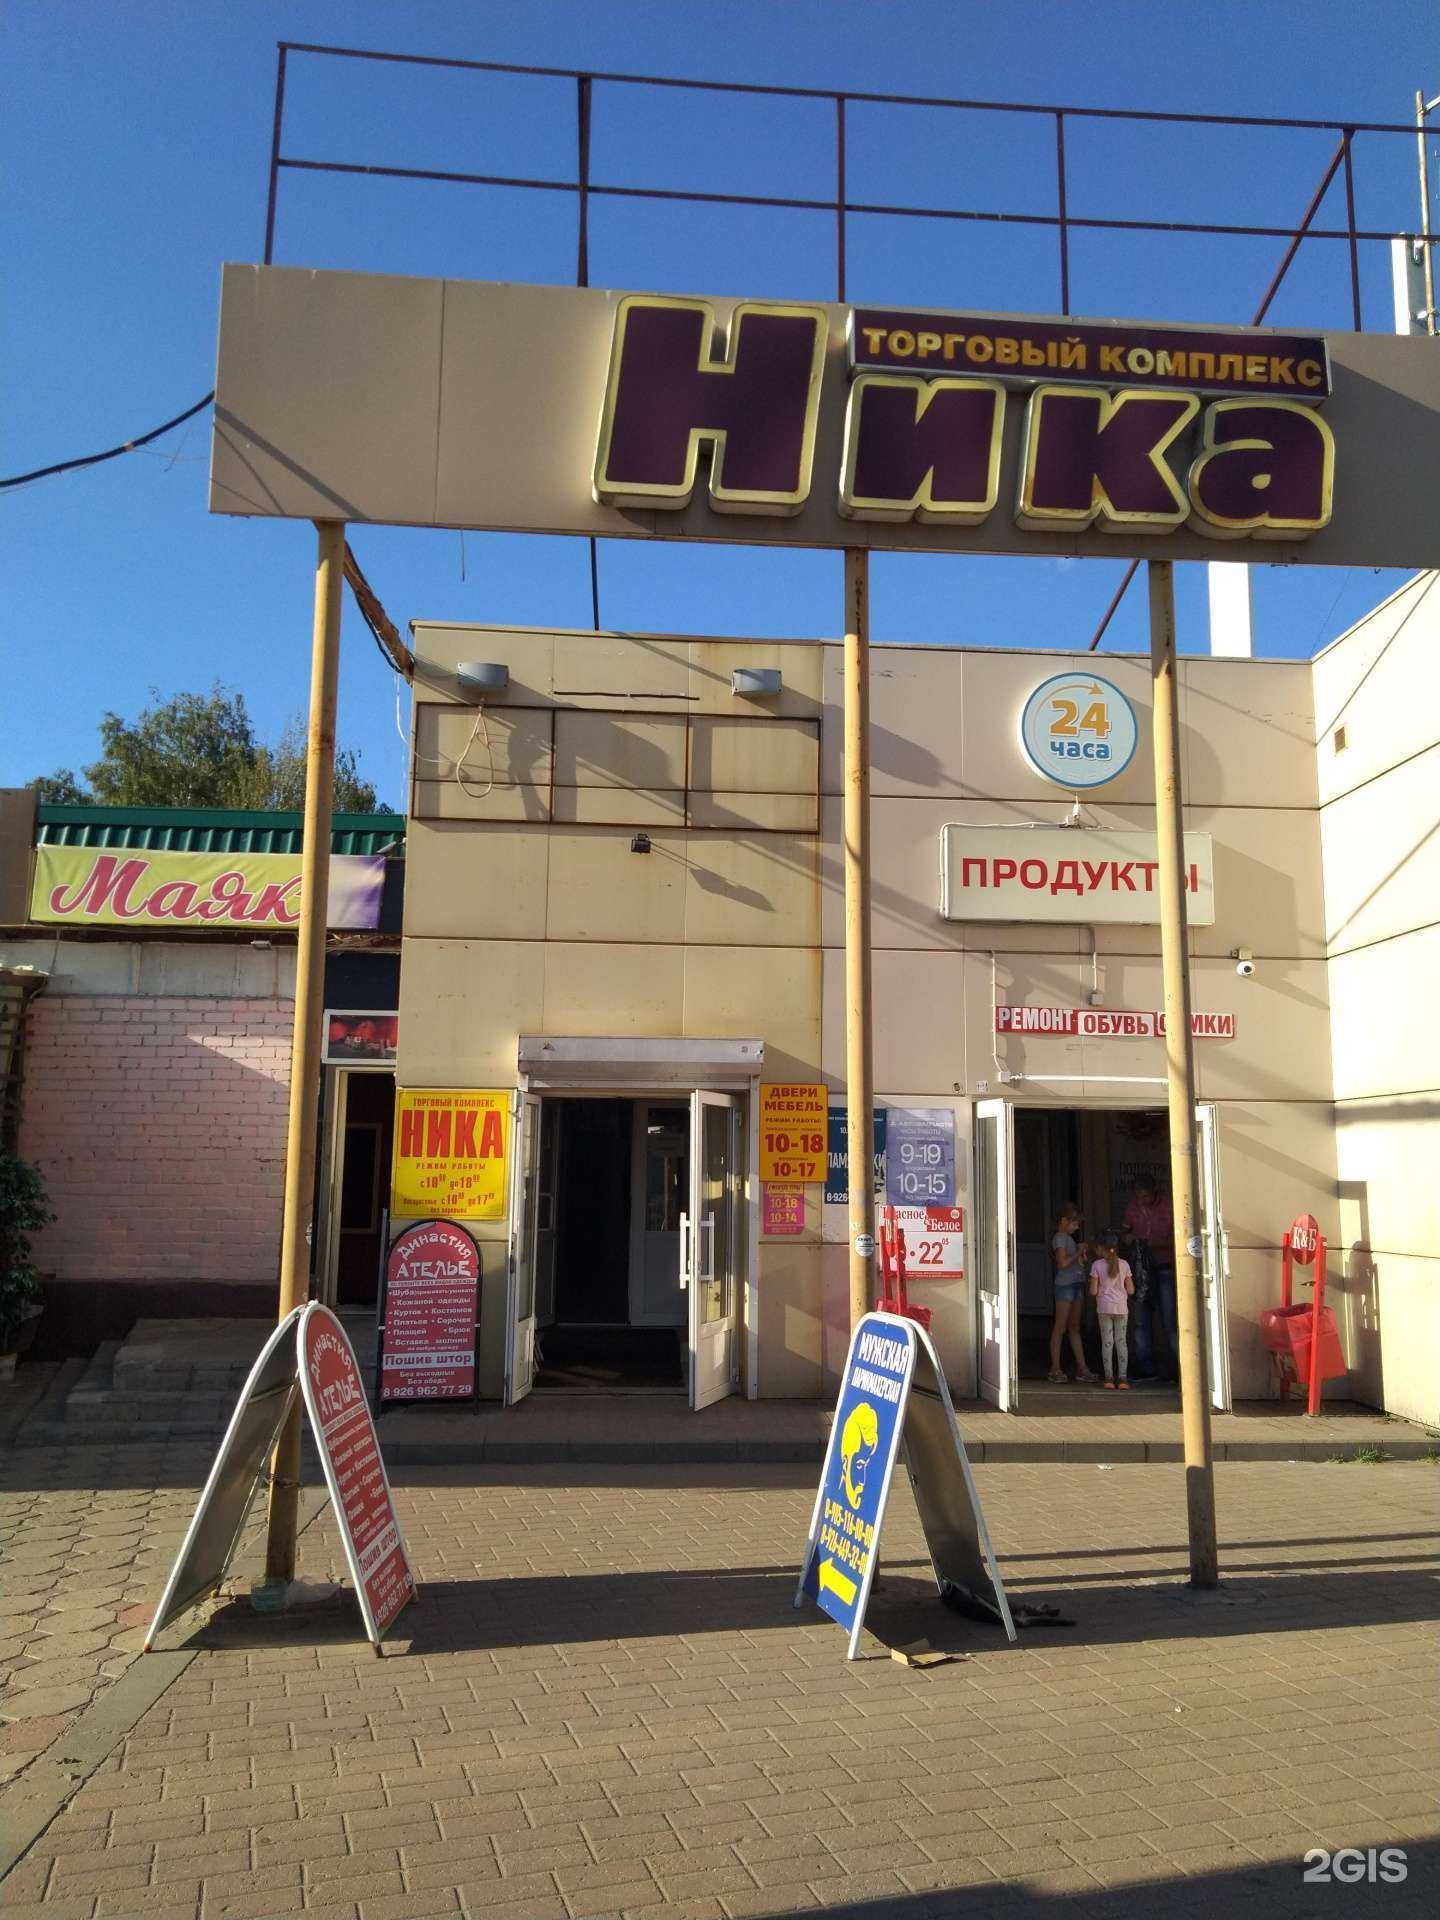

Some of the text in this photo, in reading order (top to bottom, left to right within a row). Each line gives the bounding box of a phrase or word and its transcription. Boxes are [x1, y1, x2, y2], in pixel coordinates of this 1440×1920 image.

[862, 327, 1323, 388] ТОРГОВЫЙ КОМПЛЕКС
[1049, 700, 1111, 738] 24
[1049, 741, 1111, 760] часа
[49, 855, 303, 924] Маяк
[998, 1007, 1231, 1035] РЕМОНТ ОБУВЬ СМКИ
[769, 1087, 818, 1099] ДВЕРИ
[764, 1101, 824, 1112] МЕБЕЛЬ
[400, 1109, 503, 1158] НИКА
[765, 1133, 824, 1153] 10-18
[900, 1143, 941, 1164] 9-19
[772, 1162, 816, 1177] 10-17
[896, 1172, 946, 1193] 10-15
[883, 1207, 924, 1220] асное
[931, 1218, 960, 1231] Белое
[396, 1260, 471, 1279] АТЕЛЬЕ
[385, 1354, 472, 1366] Пошив штор
[858, 1332, 911, 1375] МУЖСКАЯ
[383, 1387, 391, 1398] 8
[393, 1387, 414, 1397] 926
[416, 1386, 438, 1396] 962
[441, 1385, 455, 1394] 77
